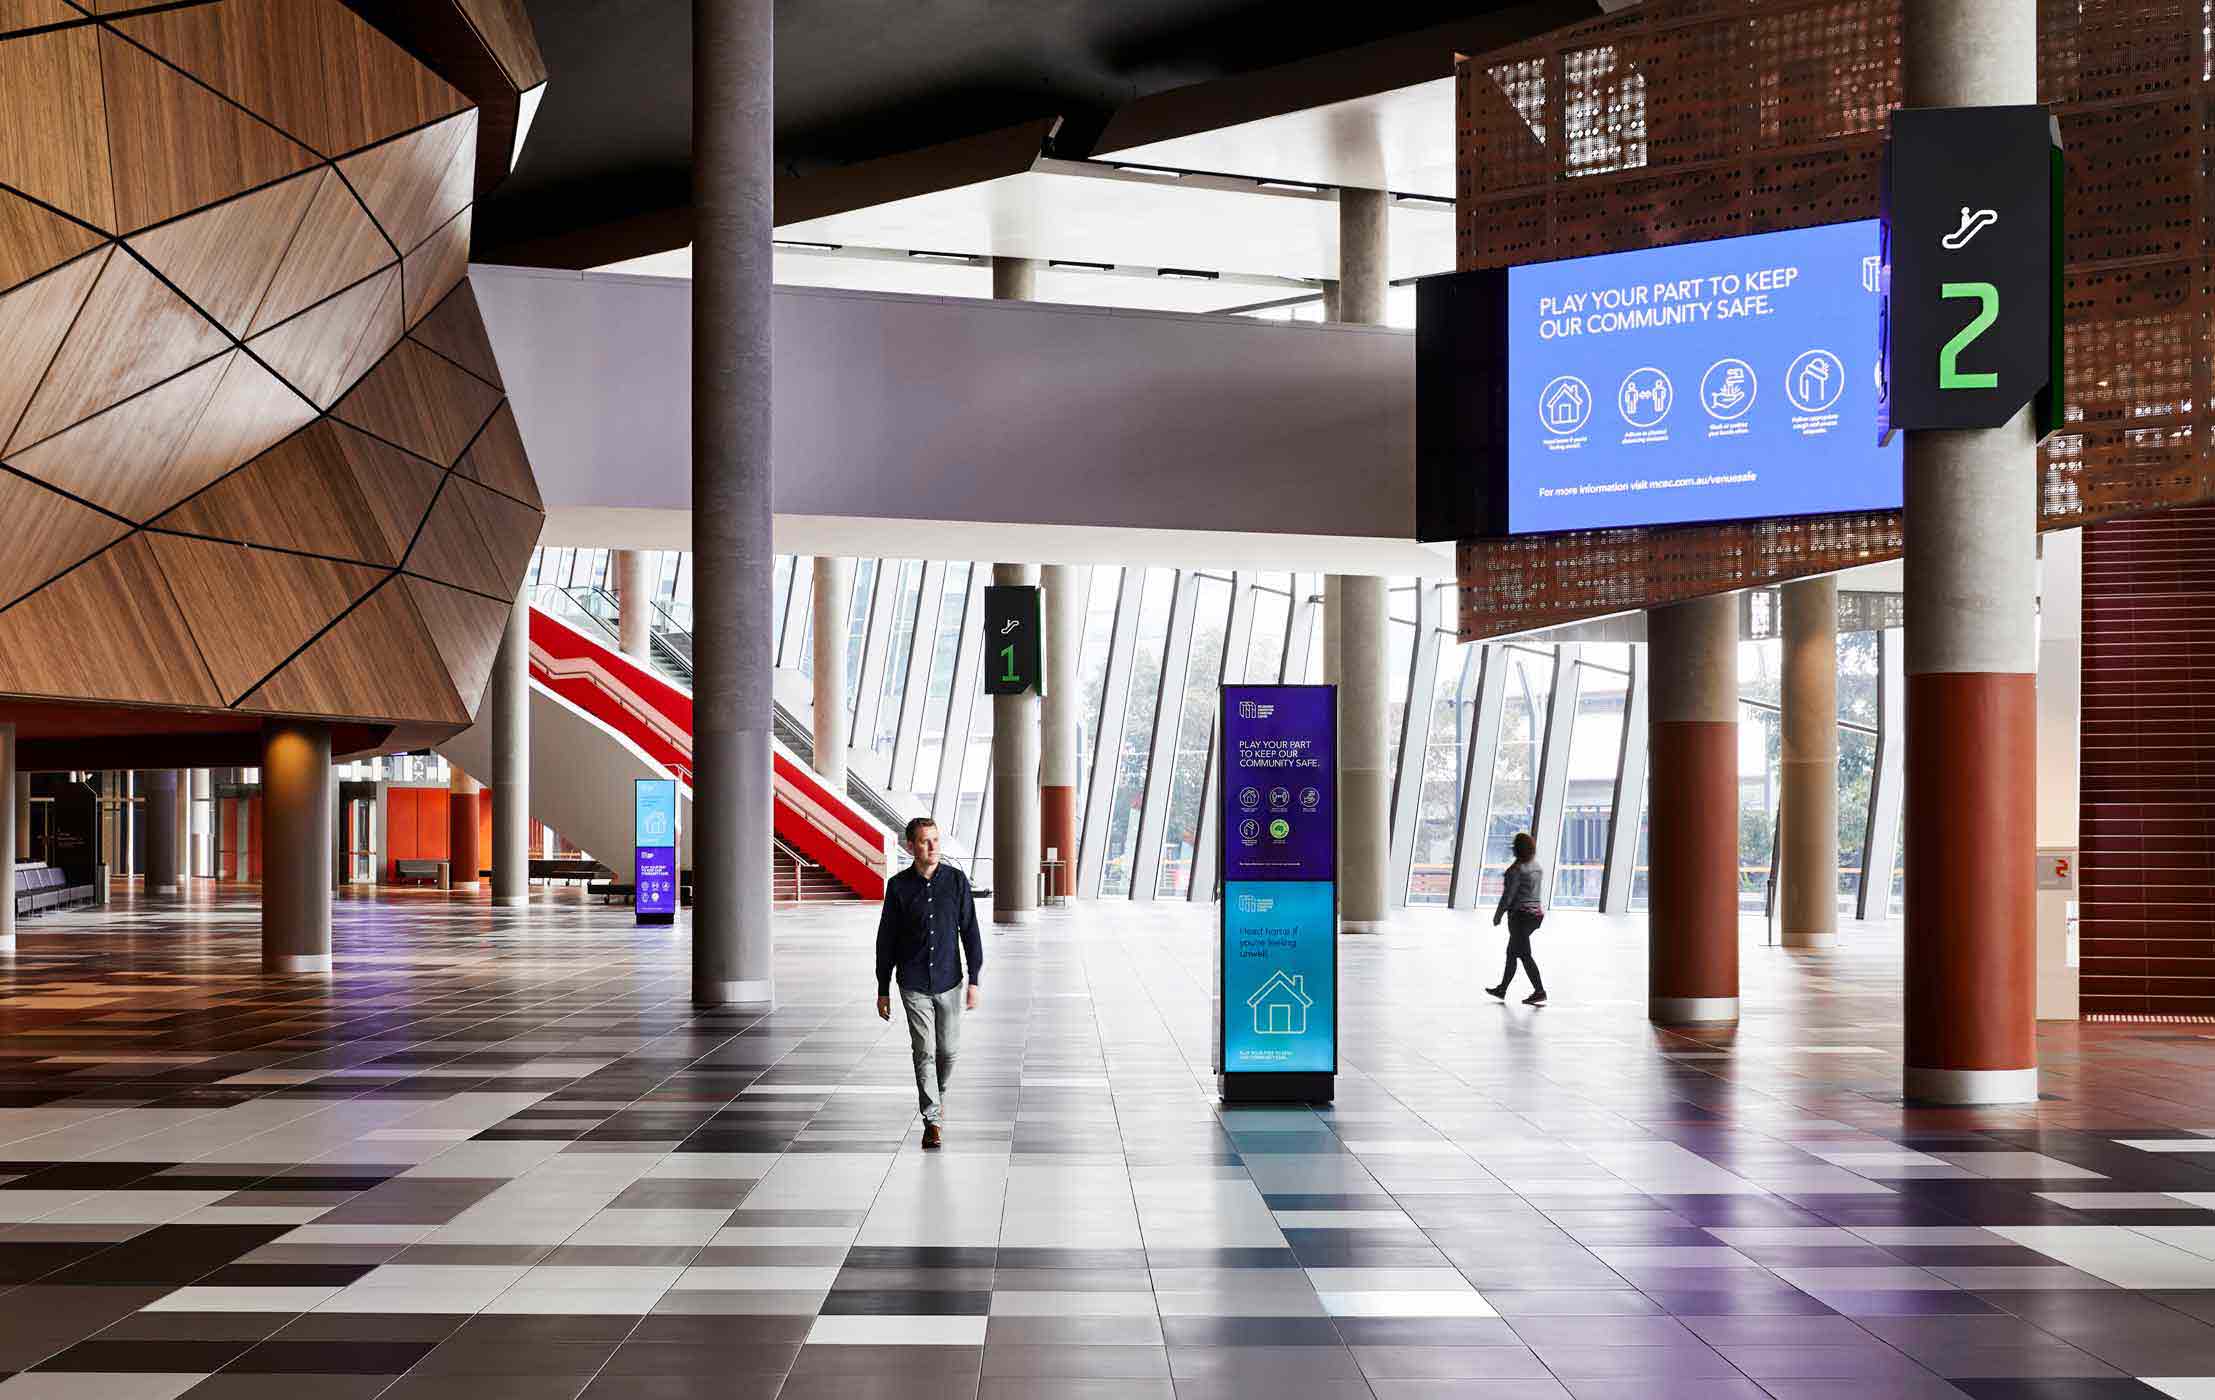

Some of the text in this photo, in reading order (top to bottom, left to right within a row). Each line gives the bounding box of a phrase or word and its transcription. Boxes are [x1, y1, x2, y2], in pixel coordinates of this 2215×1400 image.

[1540, 267, 1798, 317] PLAY YOUR PART TO KEEP
[1539, 295, 1774, 339] OUR COMMUNITY SAFE.
[1939, 282, 2000, 389] 2
[1539, 487, 1554, 497] For
[1555, 487, 1577, 496] more
[1579, 482, 1629, 495] information
[1631, 479, 1648, 490] visit
[1000, 643, 1020, 682] 1
[1240, 740, 1312, 749] PLAY YOUR PART
[1240, 749, 1298, 758] TO KEEP OUR
[1240, 759, 1320, 768] COMMUNITY SAFE.
